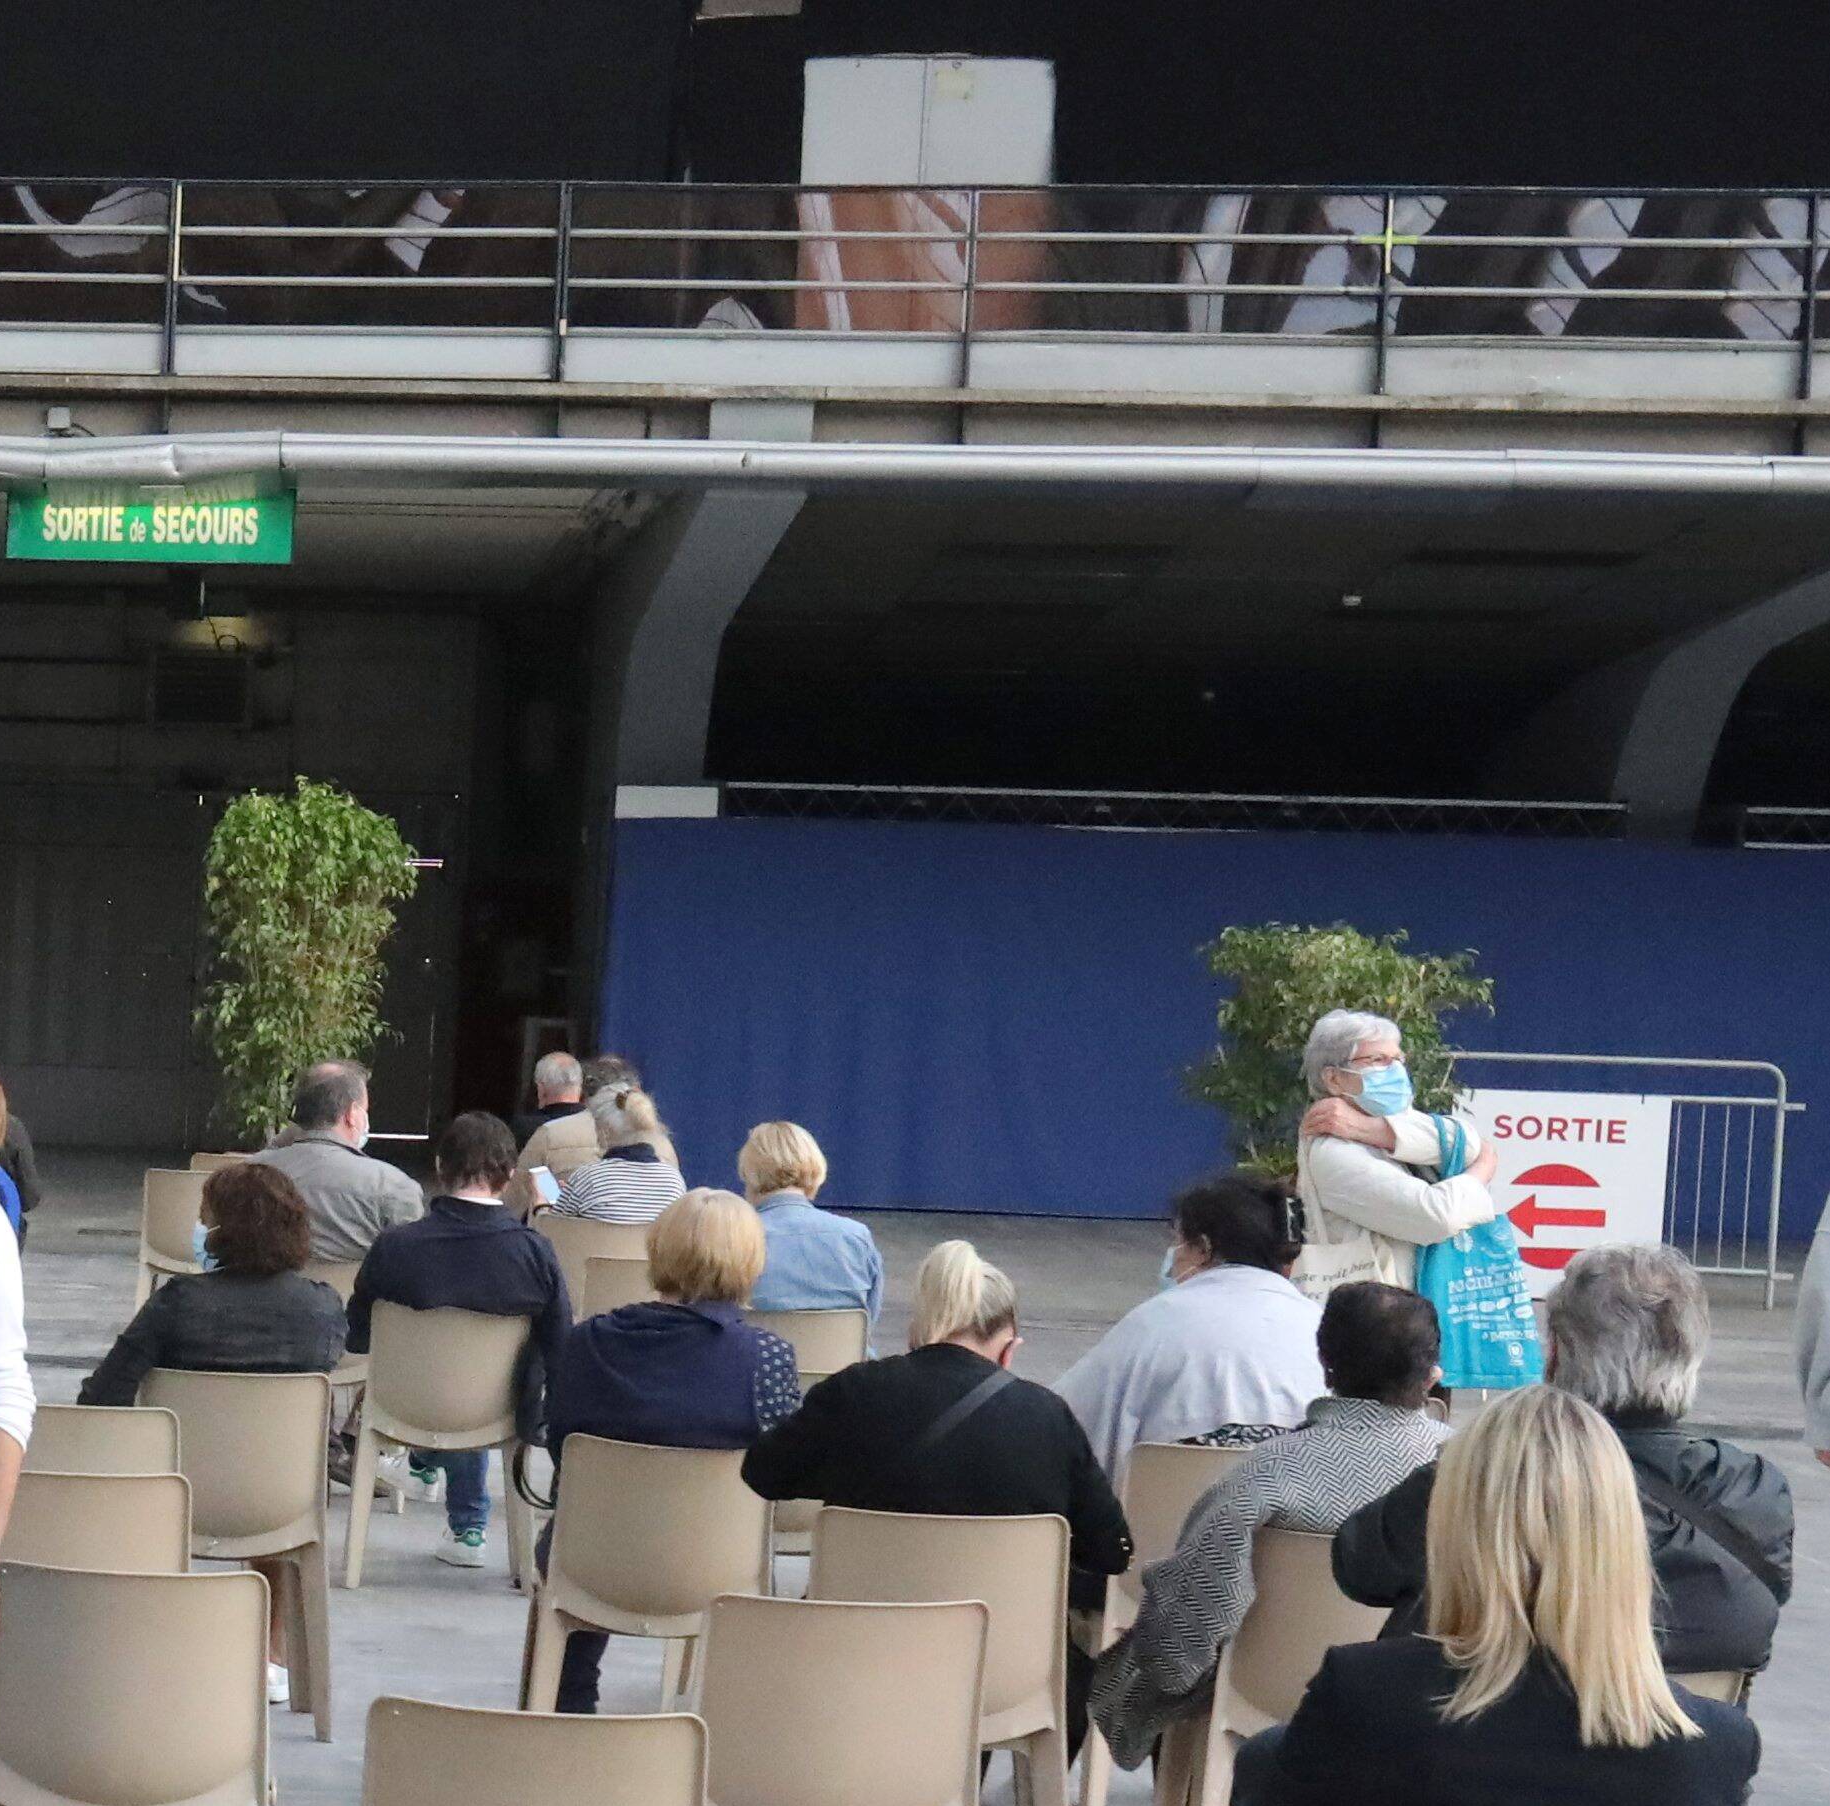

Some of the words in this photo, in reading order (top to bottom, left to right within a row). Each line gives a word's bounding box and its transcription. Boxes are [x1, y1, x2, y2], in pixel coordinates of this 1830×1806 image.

[43, 504, 124, 542] SORTIE
[129, 516, 146, 542] de
[152, 506, 259, 545] SECOURS
[1493, 1115, 1627, 1144] SORTIE
